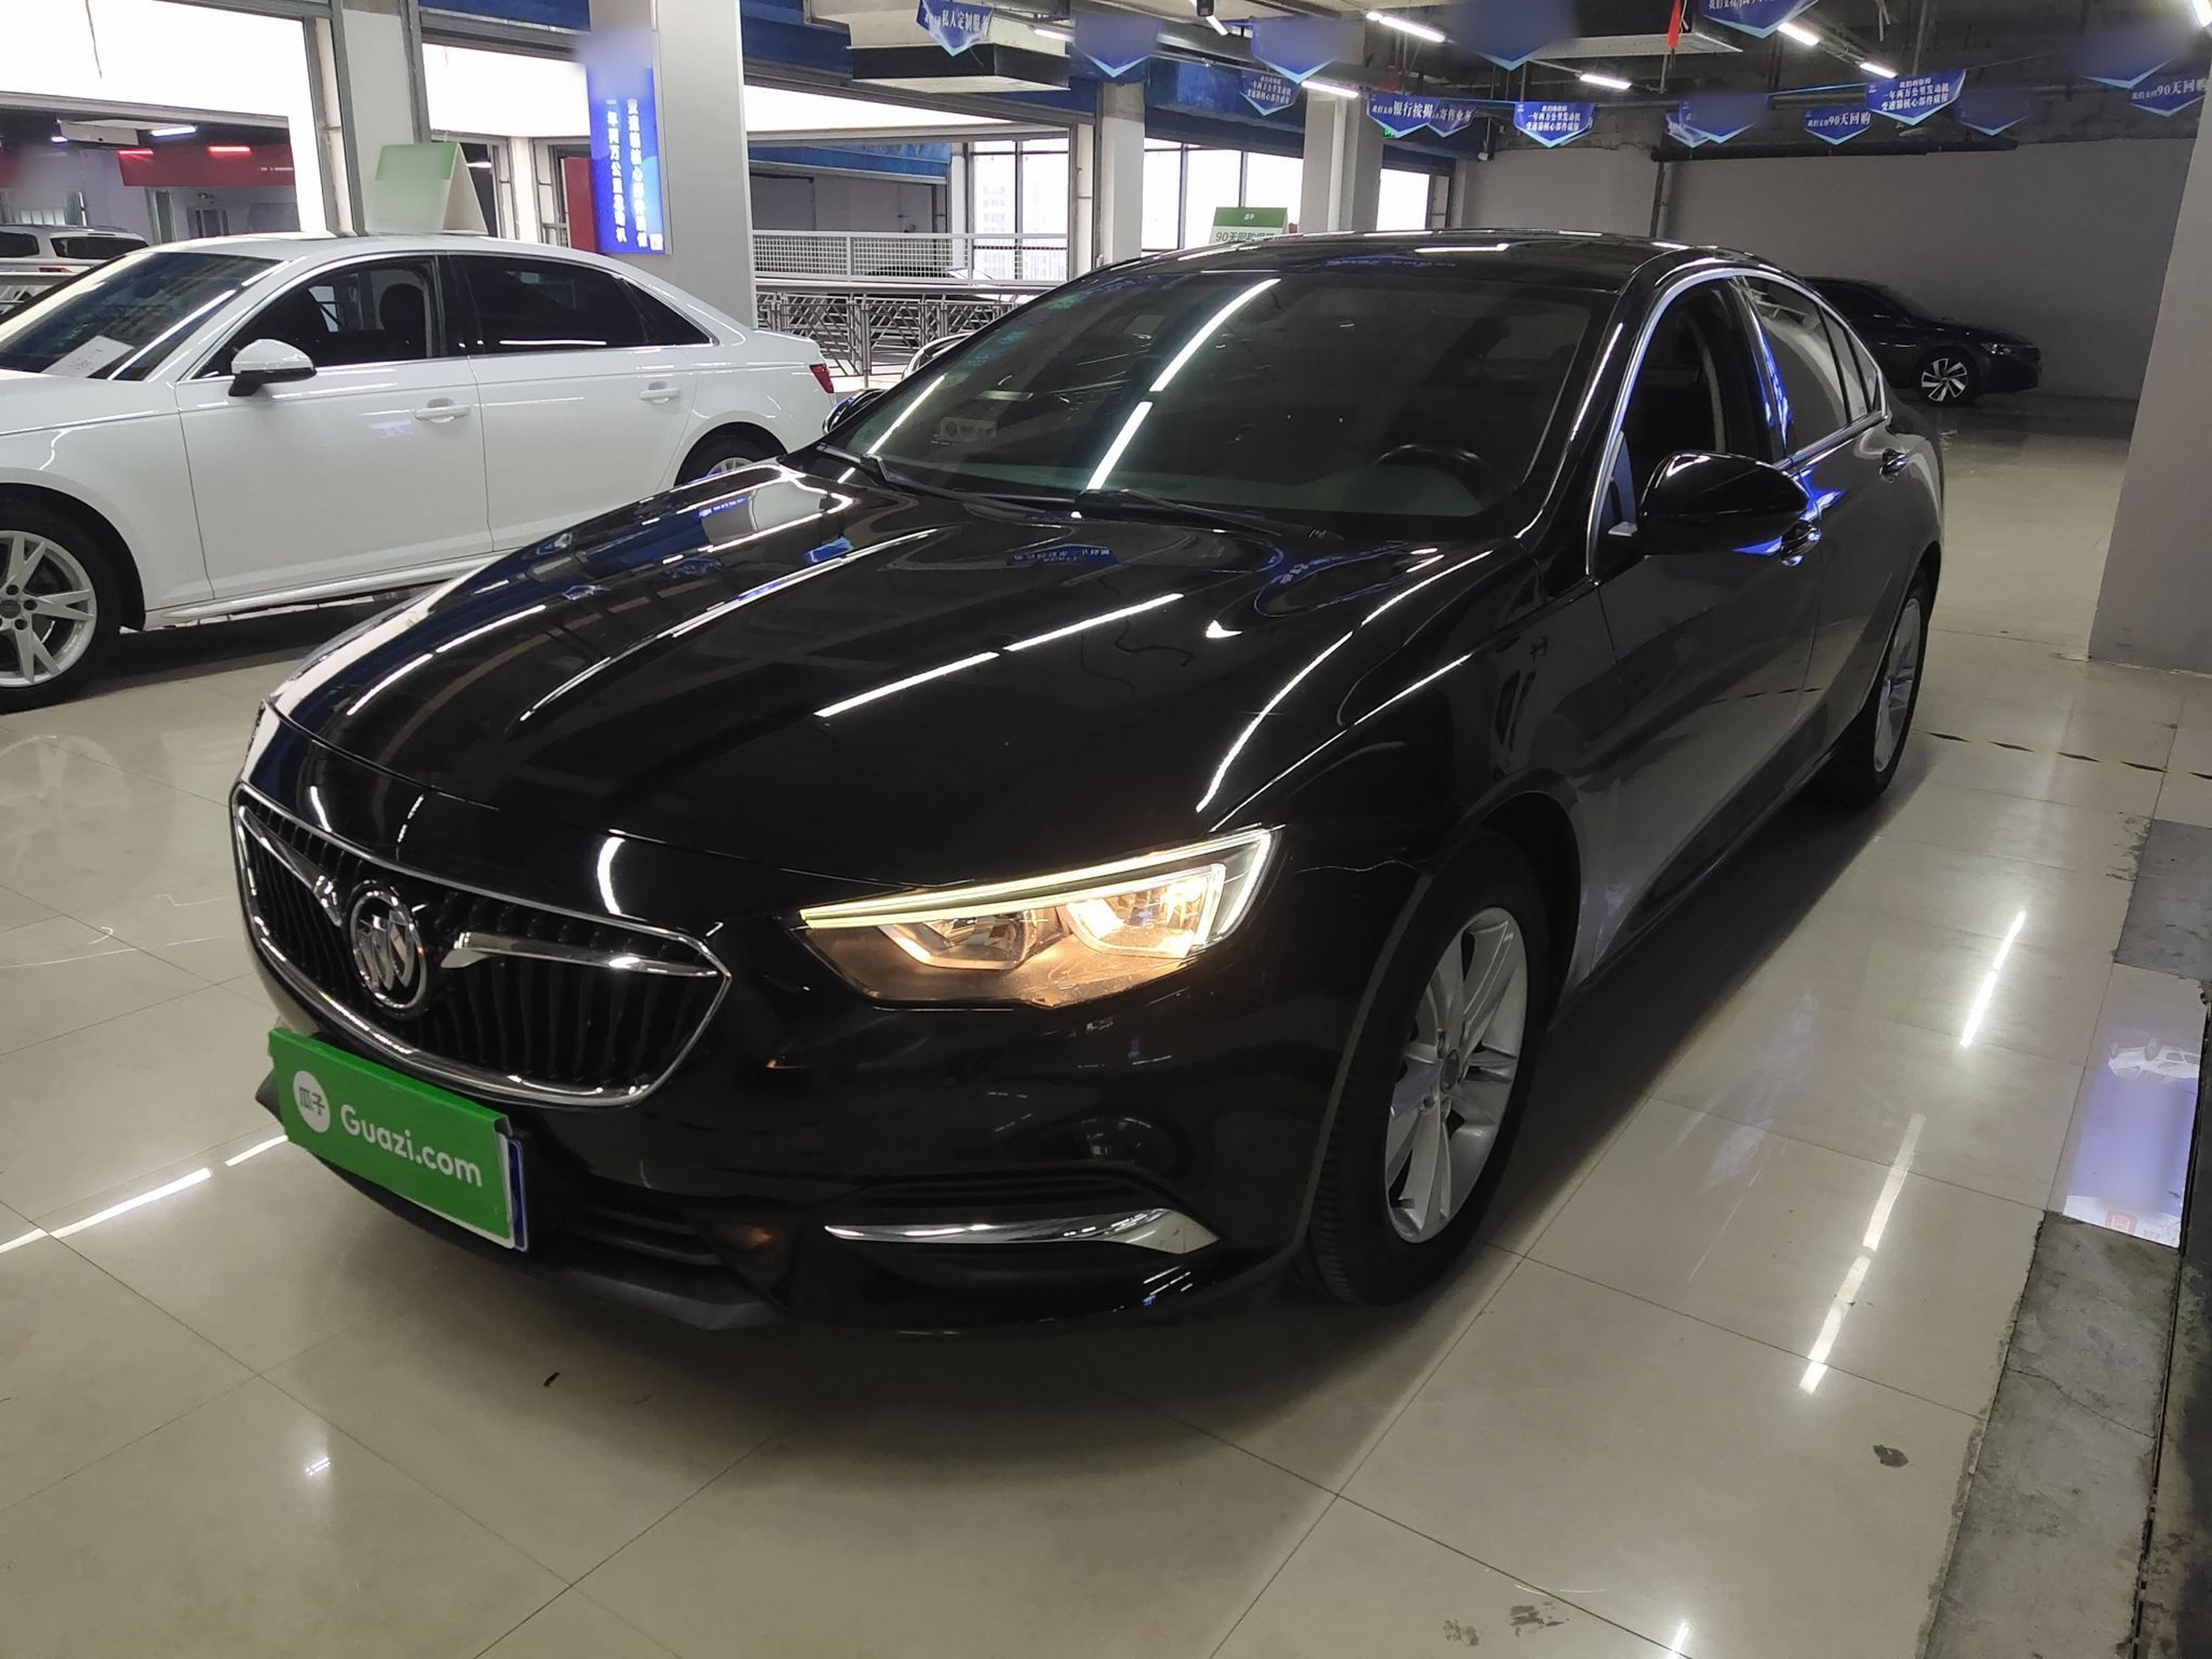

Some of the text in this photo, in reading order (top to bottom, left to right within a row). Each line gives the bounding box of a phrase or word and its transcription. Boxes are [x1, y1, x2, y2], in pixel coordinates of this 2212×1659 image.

[1881, 93, 1948, 111] 变速箱核心部件质保
[1882, 82, 1949, 100] 一年两万公里发动机
[298, 1086, 326, 1116] 瓜子
[340, 1104, 482, 1188] Guazi.com
